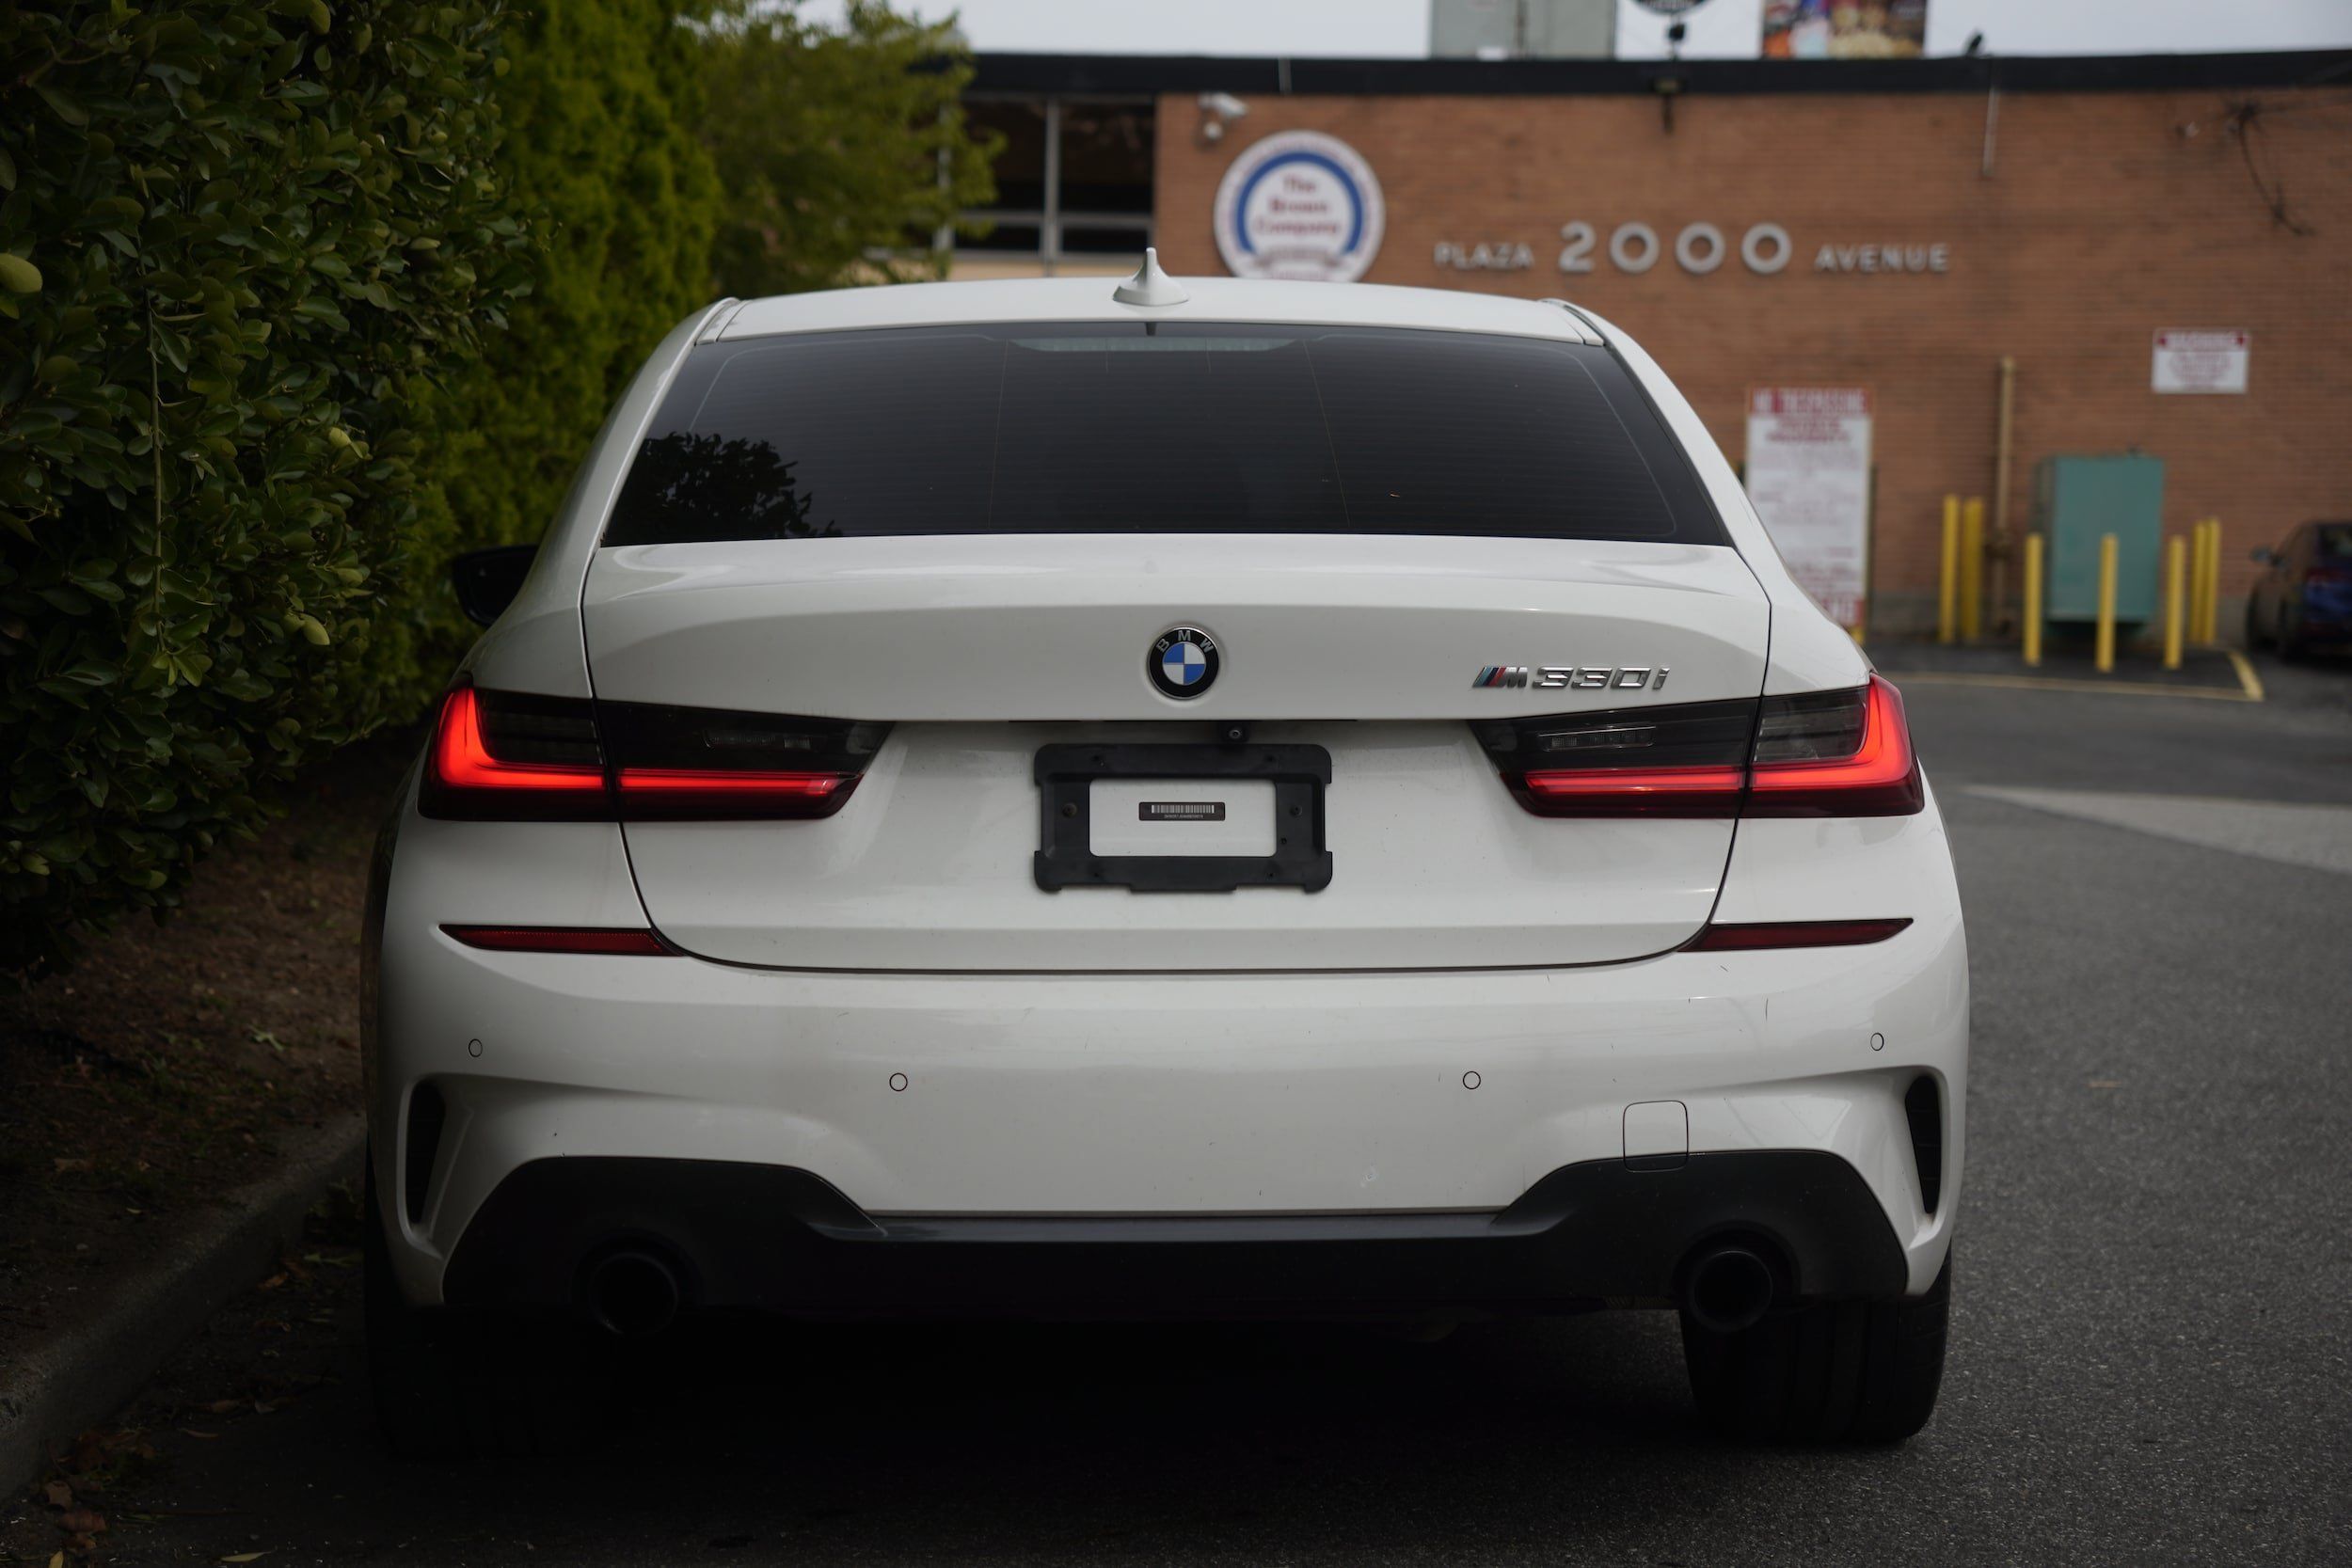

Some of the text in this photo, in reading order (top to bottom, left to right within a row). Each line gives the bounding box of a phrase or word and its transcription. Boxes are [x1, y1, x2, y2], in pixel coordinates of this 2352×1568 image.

[1434, 219, 1949, 275] PLAZA 2000 AVENUE
[1155, 629, 1215, 653] BMW
[1532, 666, 1671, 690] 330i
